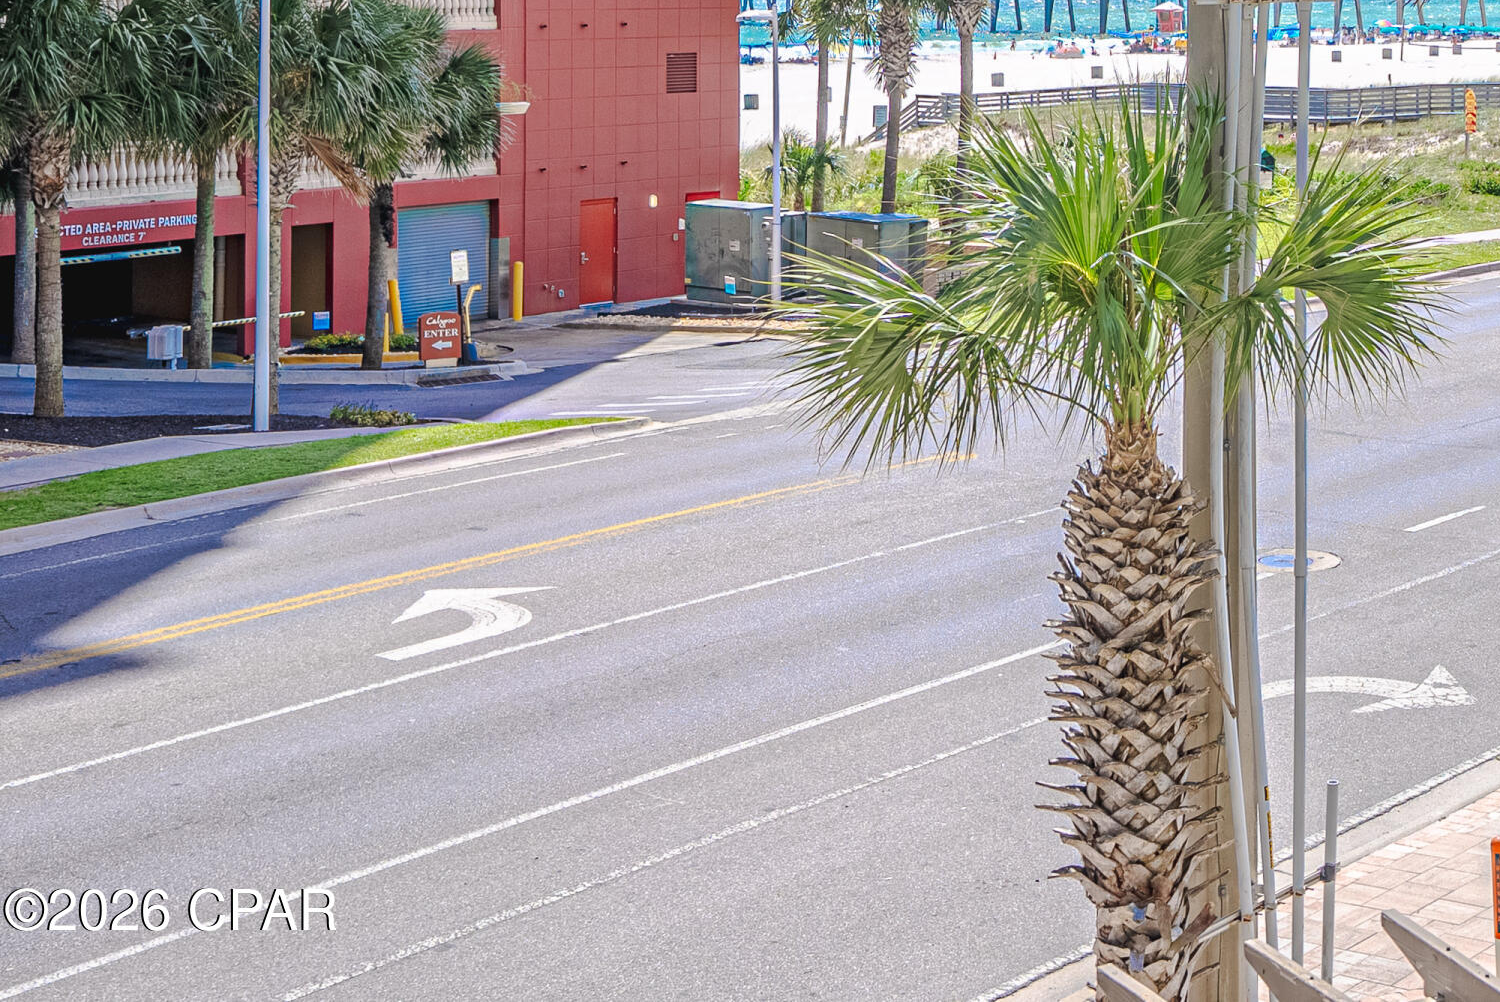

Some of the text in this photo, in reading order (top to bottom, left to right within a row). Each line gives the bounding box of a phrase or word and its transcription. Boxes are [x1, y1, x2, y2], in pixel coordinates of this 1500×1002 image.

[158, 214, 198, 227] PARKING
[82, 232, 135, 246] CLEARANCE
[426, 314, 457, 329] Calypso
[423, 328, 459, 338] ENTER
